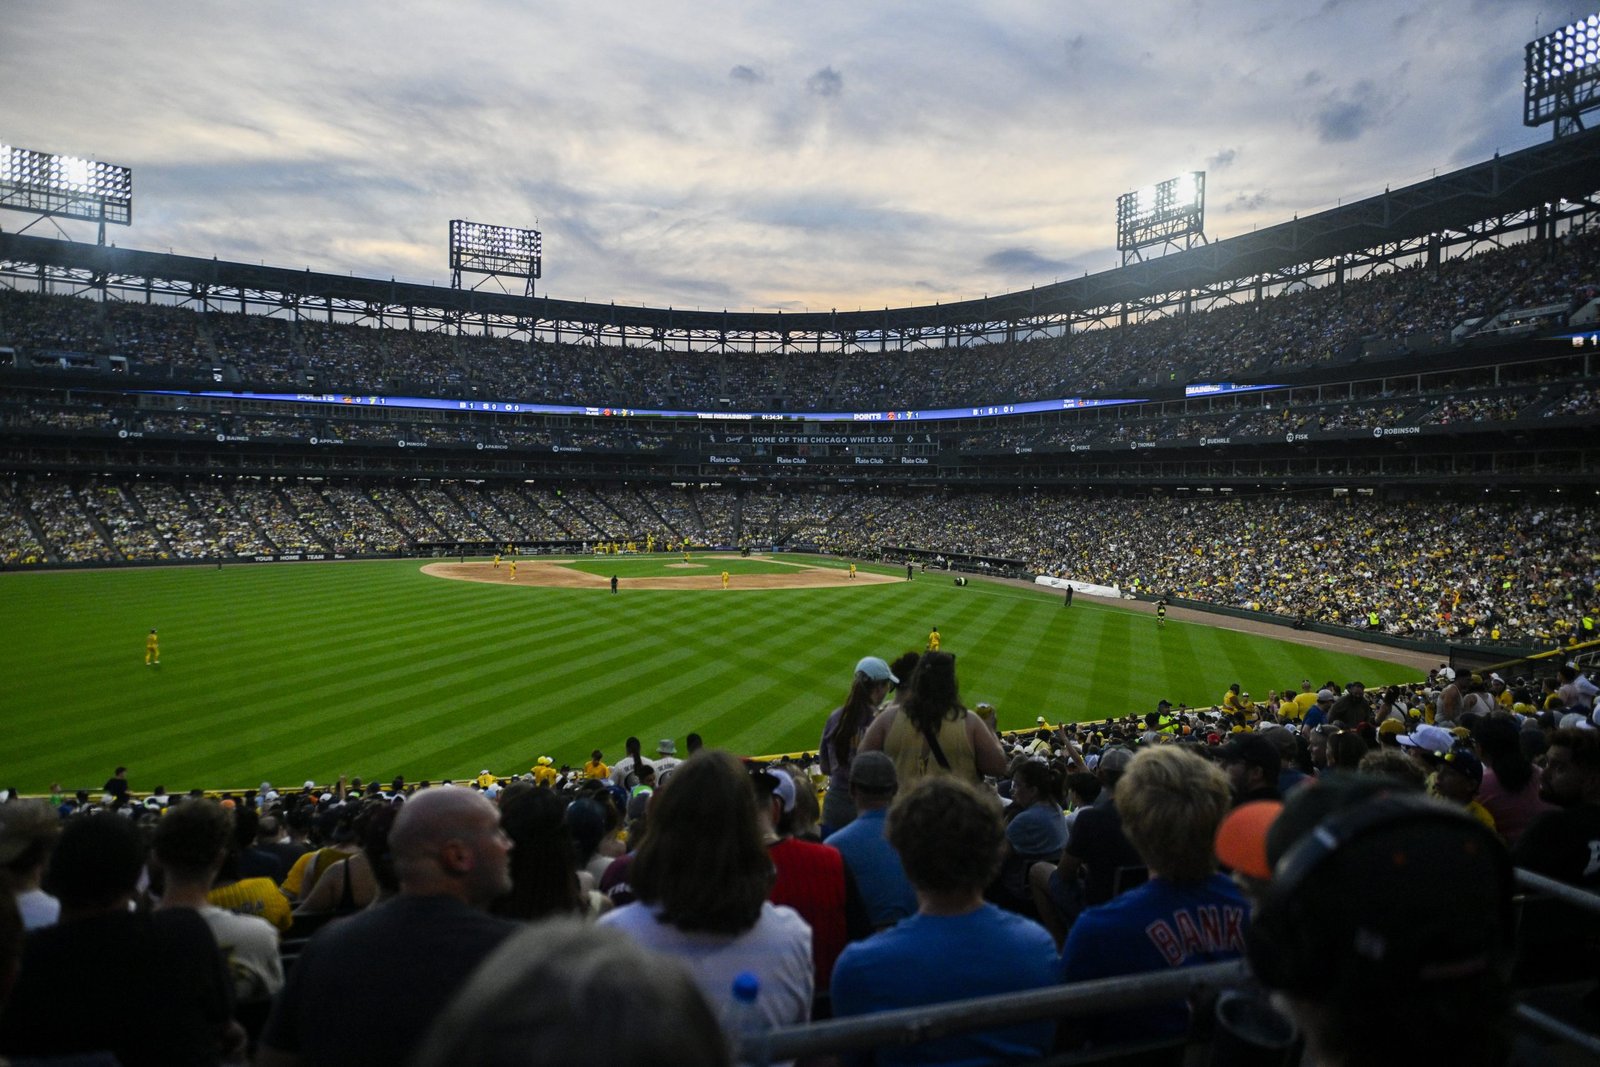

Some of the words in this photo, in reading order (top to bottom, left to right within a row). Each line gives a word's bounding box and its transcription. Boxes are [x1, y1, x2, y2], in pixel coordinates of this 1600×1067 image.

[1591, 334, 1598, 346] 1
[1383, 427, 1420, 435] ROBINSON
[710, 455, 725, 463] Rate
[776, 456, 792, 464] Rate
[901, 456, 915, 464] Rate
